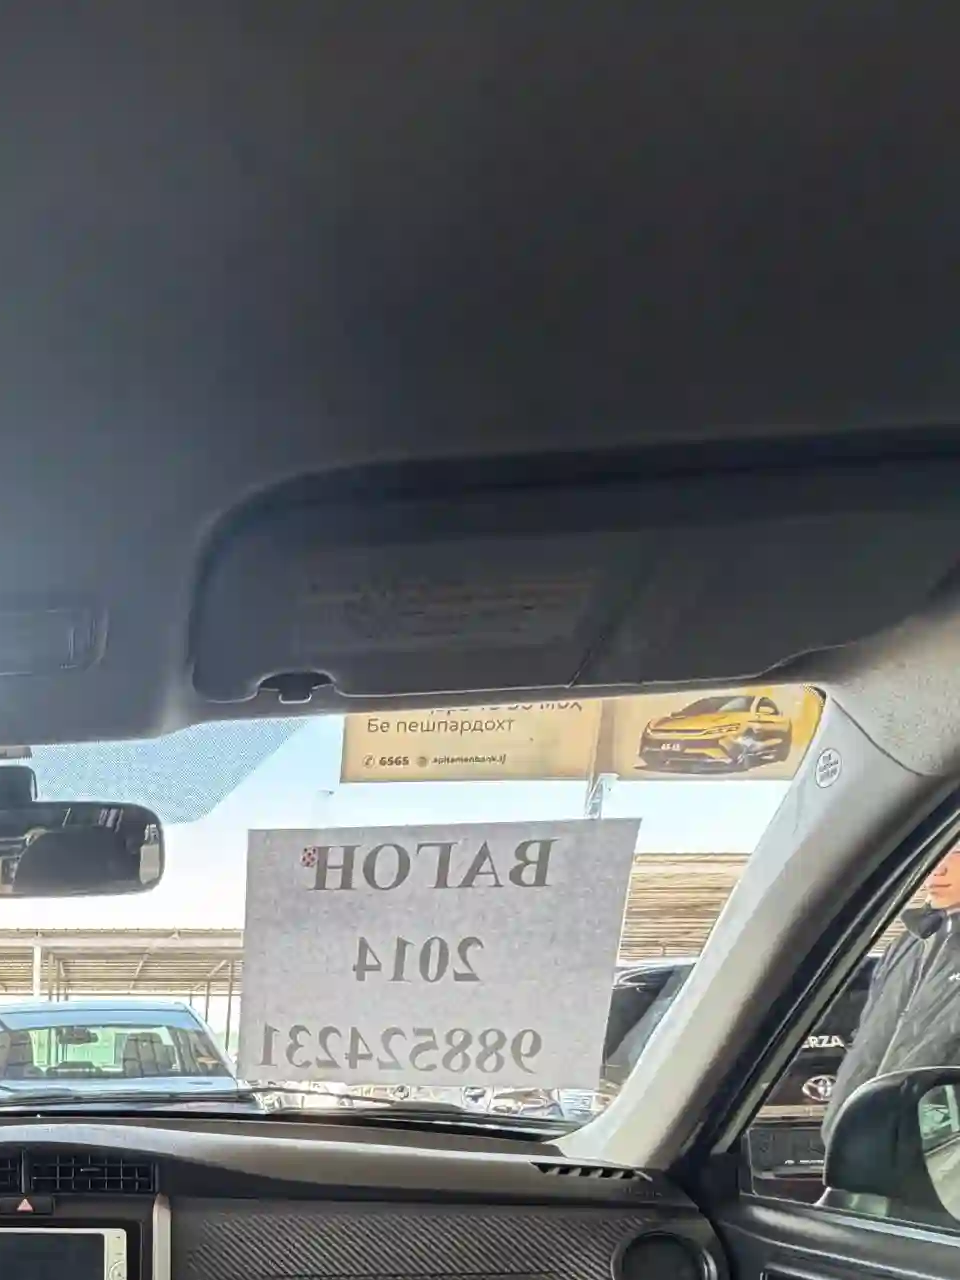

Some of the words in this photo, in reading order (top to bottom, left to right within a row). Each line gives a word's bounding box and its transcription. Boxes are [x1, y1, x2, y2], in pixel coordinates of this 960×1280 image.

[367, 717, 390, 734] Бе
[396, 717, 515, 736] пешпардохт
[378, 755, 410, 767] 6565
